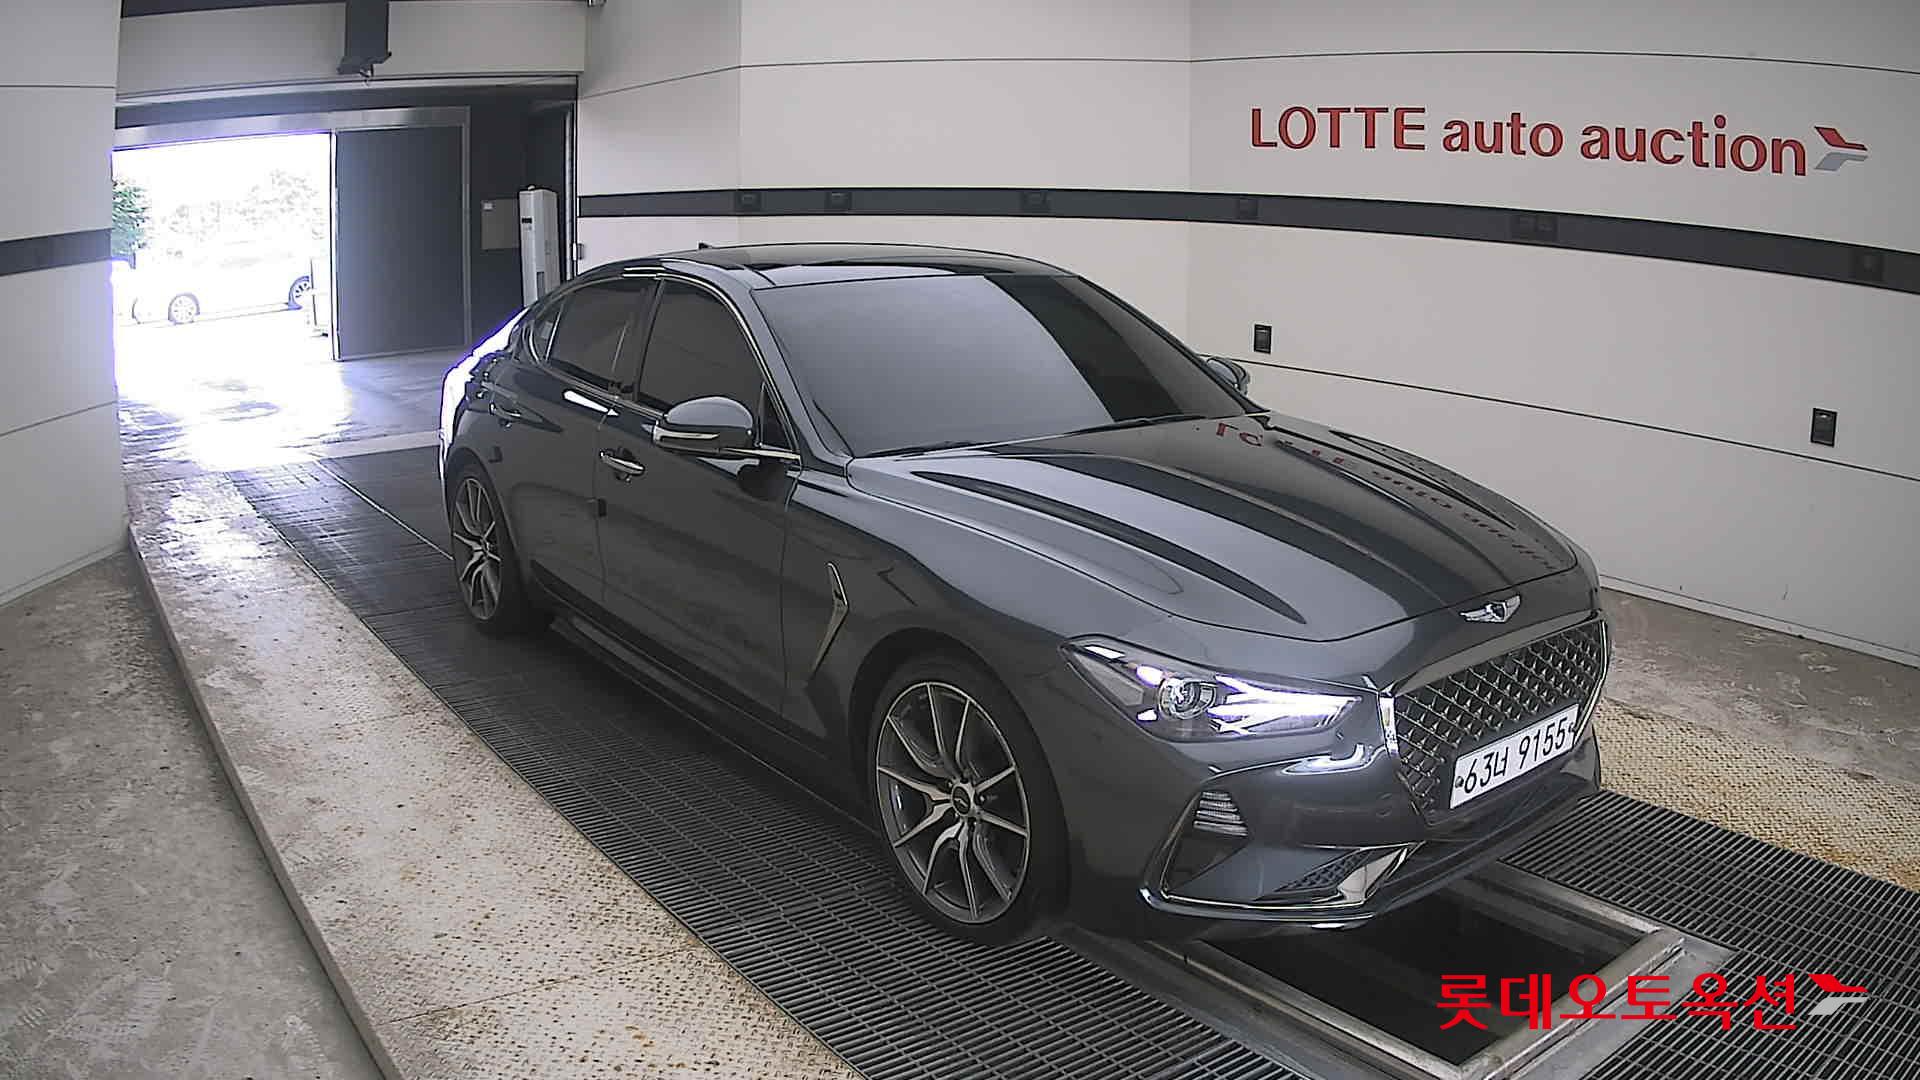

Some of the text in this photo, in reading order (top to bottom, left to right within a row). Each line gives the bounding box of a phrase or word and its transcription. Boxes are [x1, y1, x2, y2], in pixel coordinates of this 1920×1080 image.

[1250, 105, 1808, 177] LOTTE auto auction
[1464, 716, 1568, 793] 63너 9155
